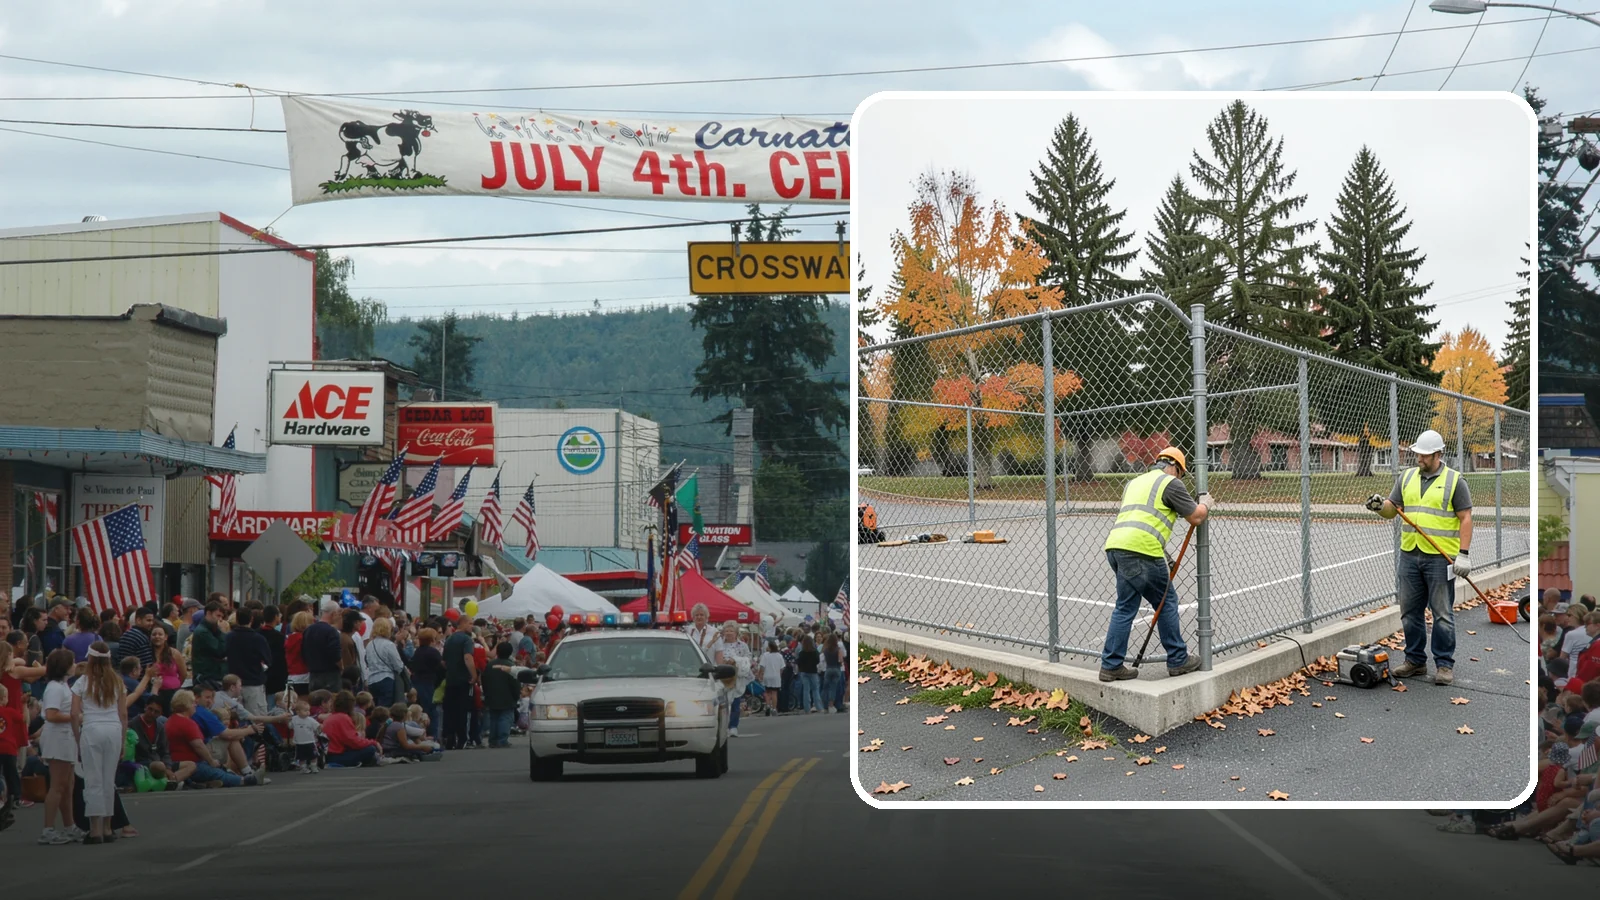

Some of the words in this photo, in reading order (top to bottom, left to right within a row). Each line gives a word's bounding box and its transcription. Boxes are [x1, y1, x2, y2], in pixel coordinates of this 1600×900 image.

[481, 141, 605, 192] JULY
[632, 150, 746, 198] 4th.
[697, 254, 850, 280] CROSSWA
[283, 379, 374, 420] ACE
[405, 409, 452, 422] CEDAR
[283, 421, 371, 437] Hardware
[416, 428, 477, 447] Coca-Cola
[353, 467, 384, 481] Simpl
[83, 485, 93, 494] St.
[95, 485, 124, 495] Vincent
[126, 486, 136, 495] de
[138, 486, 155, 496] Paul
[80, 503, 154, 522] THT
[688, 526, 741, 535] CRNATION
[699, 535, 730, 543] GLASS
